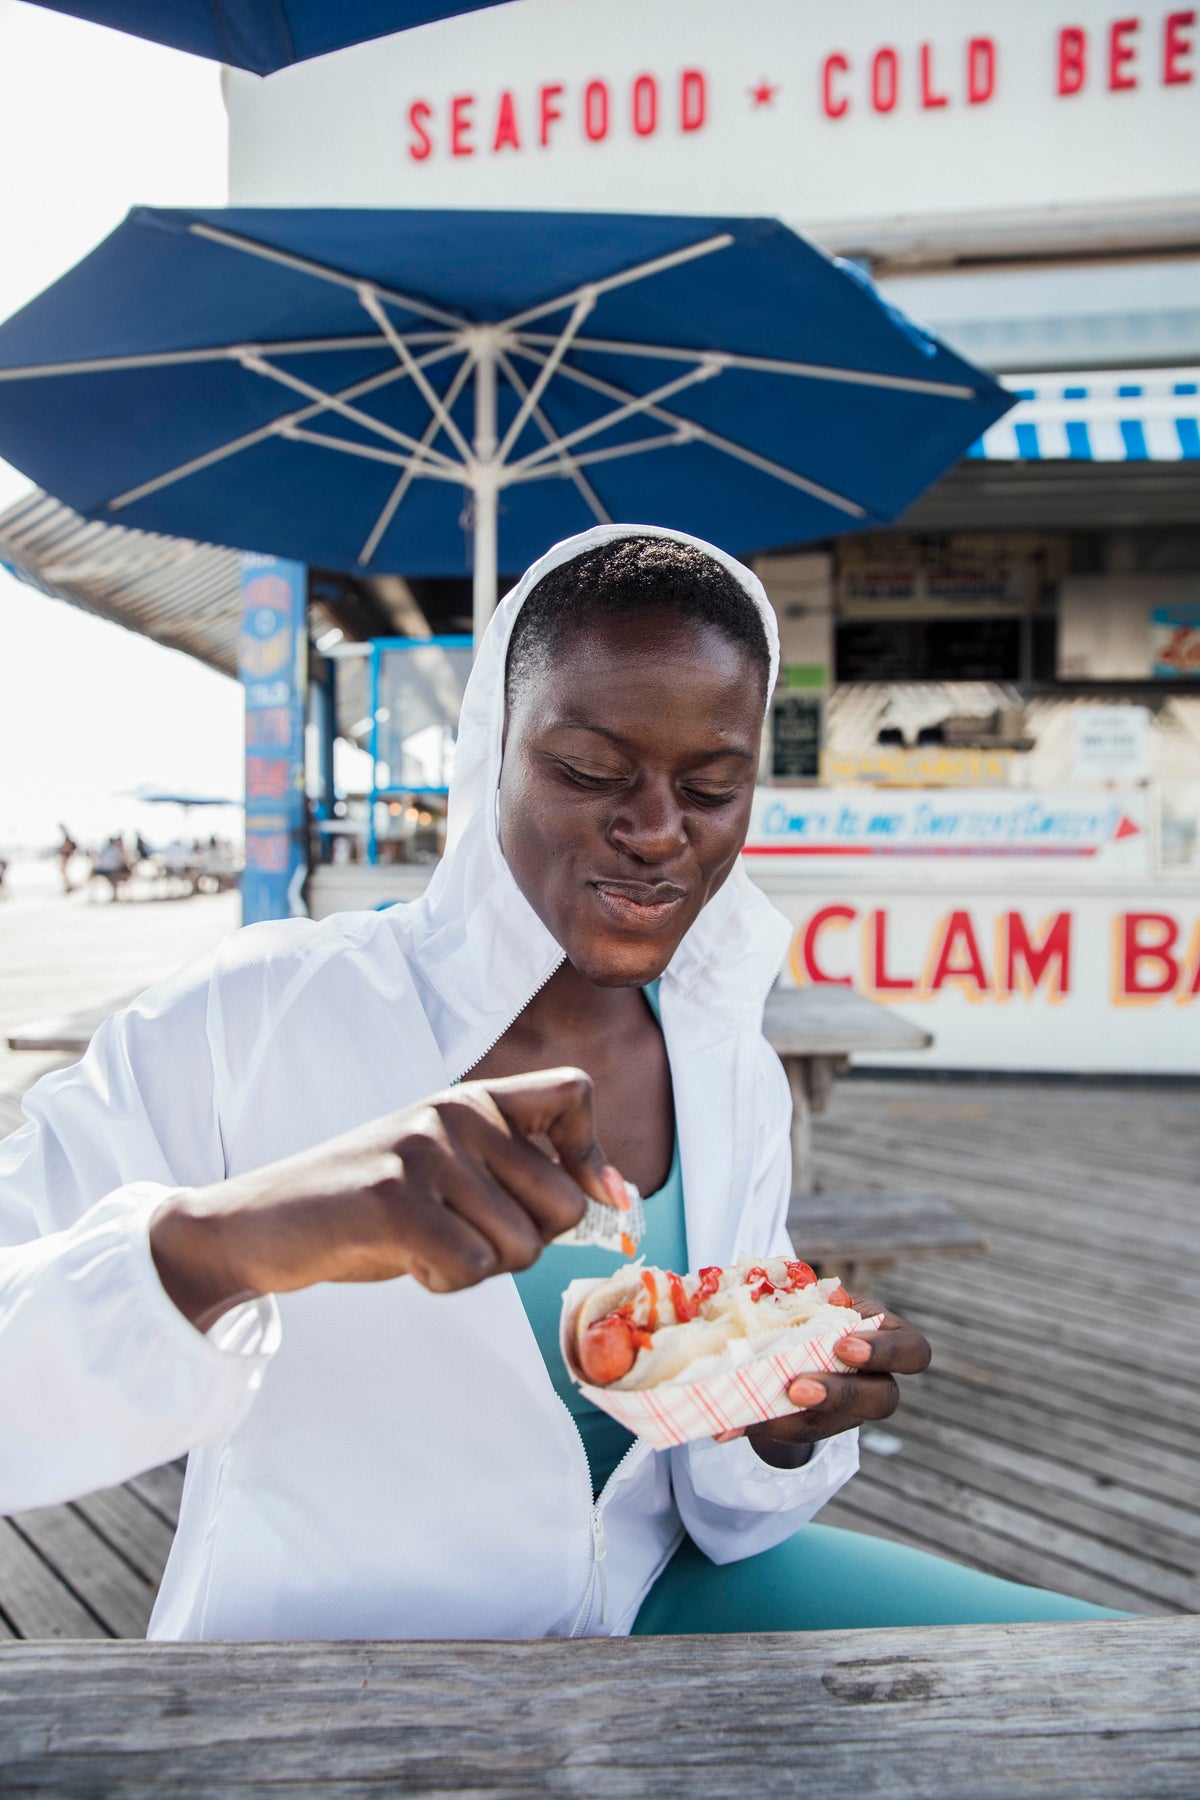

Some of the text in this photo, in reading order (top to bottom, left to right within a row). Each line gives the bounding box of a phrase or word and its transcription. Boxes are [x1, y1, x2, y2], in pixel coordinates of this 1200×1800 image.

[406, 68, 709, 162] SEAFOOD
[821, 36, 997, 119] COLD
[790, 903, 1073, 1002] CLAM
